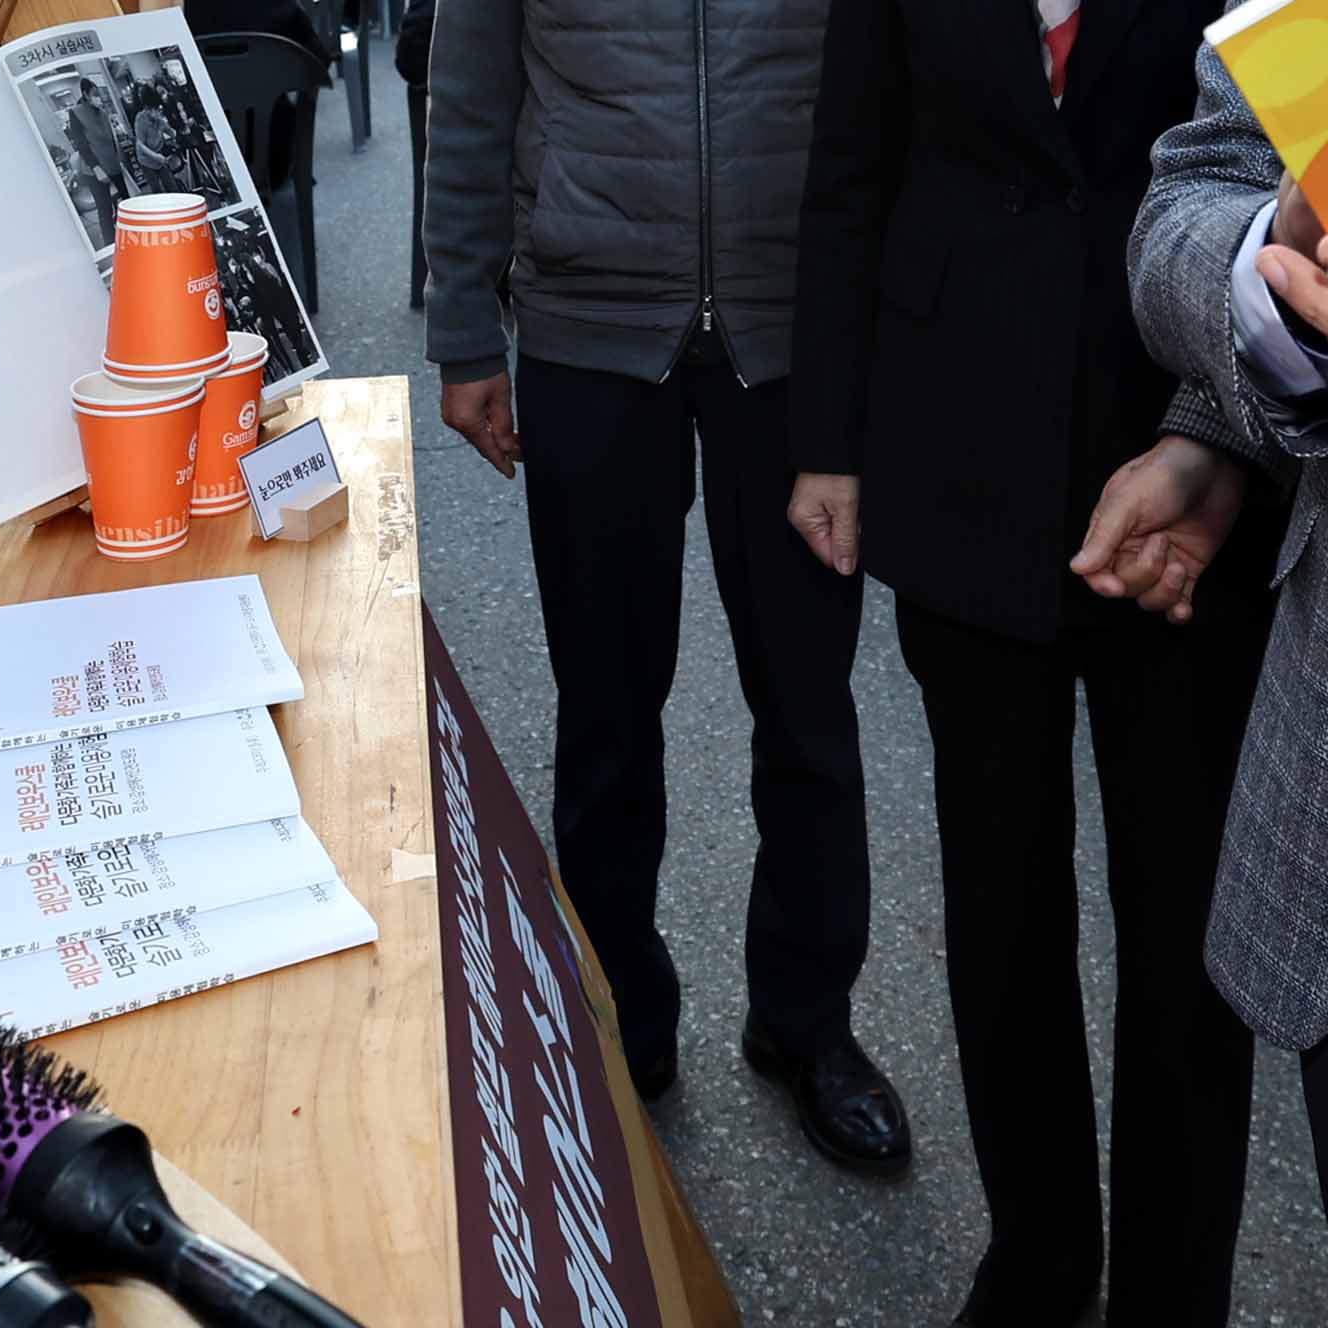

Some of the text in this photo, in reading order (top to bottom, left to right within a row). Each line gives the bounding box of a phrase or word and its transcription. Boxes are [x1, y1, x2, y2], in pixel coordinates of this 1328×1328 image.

[18, 46, 55, 69] 3차시
[259, 451, 327, 501] 눈으로만 봐주세요
[14, 762, 52, 834] 레인보우스쿨
